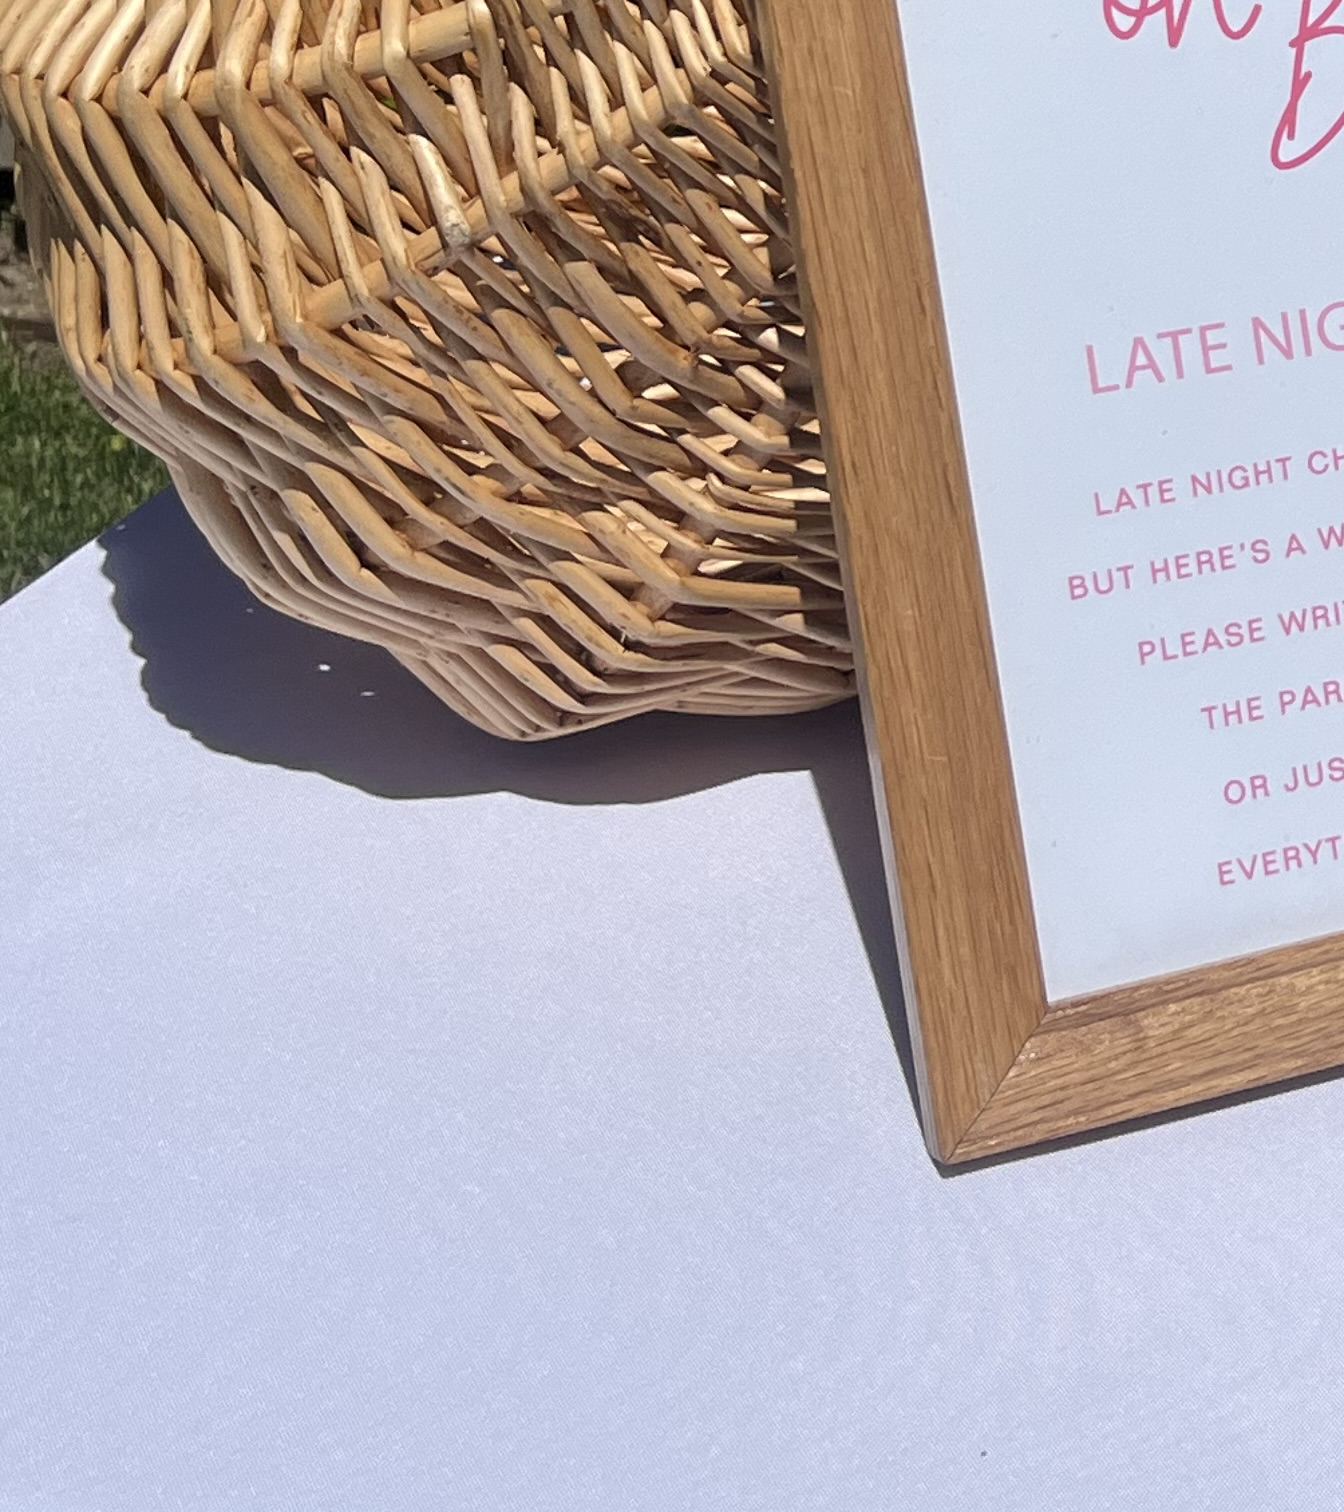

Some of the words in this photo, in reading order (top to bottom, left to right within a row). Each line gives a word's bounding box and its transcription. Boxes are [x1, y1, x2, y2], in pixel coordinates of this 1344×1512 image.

[1085, 322, 1233, 395] LATE
[1093, 478, 1176, 517] LATE
[1189, 456, 1292, 498] NIGHT
[1066, 564, 1133, 601] BUT
[1149, 538, 1272, 584] HERE'S
[1284, 533, 1307, 558] A
[1137, 617, 1265, 665] PLEASE
[1200, 696, 1264, 729] THE
[1222, 774, 1271, 806] OR
